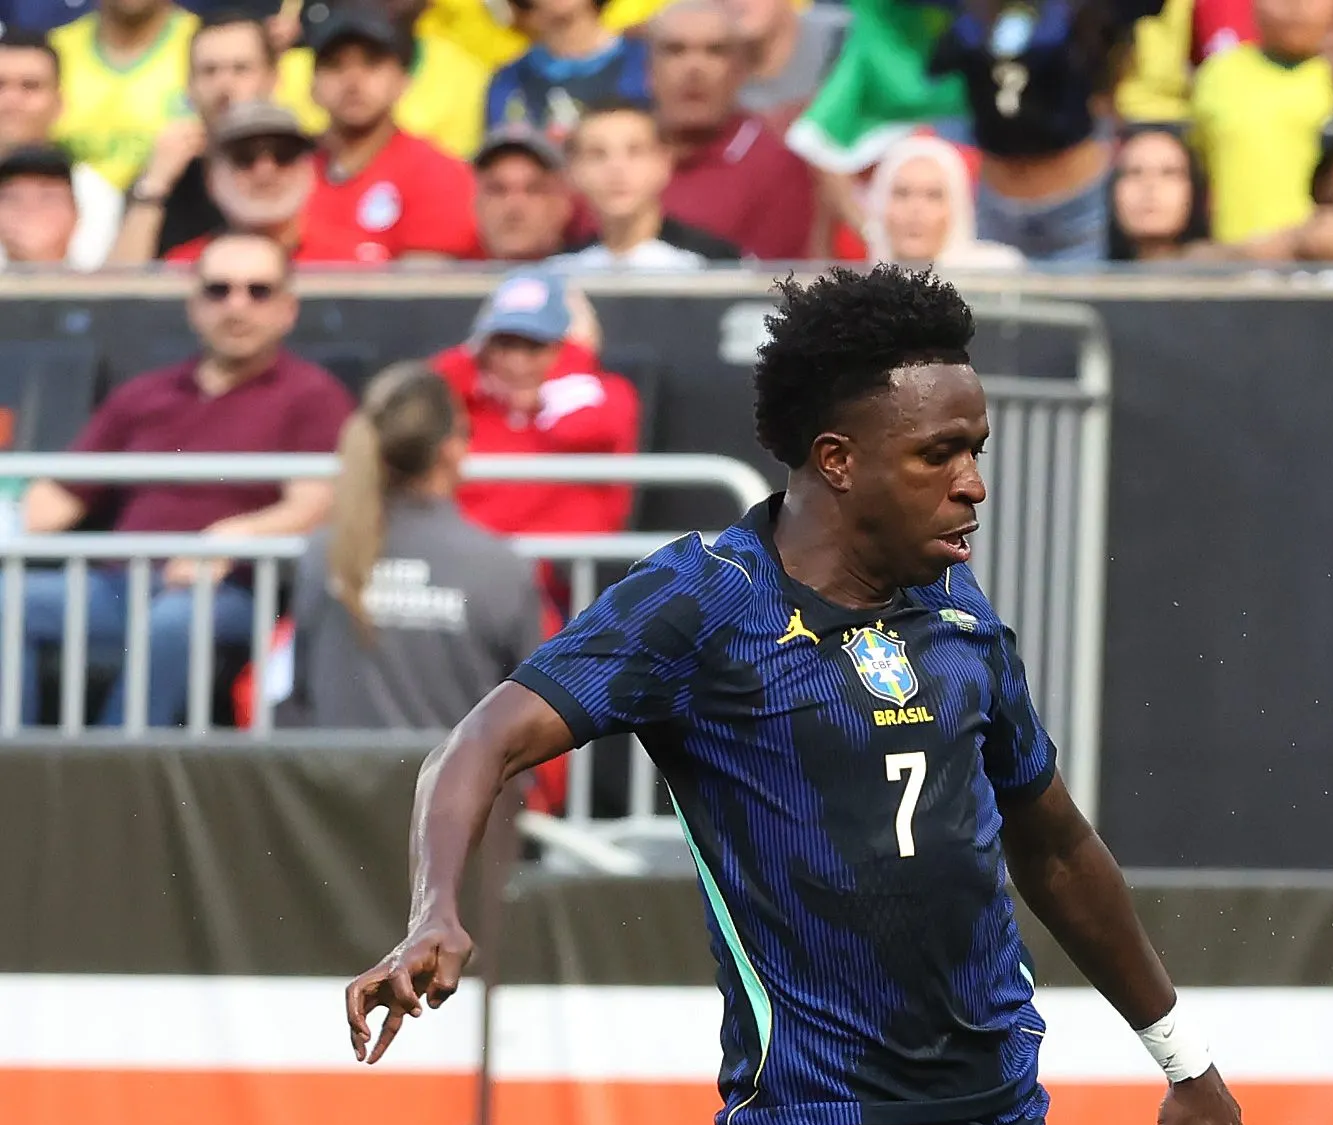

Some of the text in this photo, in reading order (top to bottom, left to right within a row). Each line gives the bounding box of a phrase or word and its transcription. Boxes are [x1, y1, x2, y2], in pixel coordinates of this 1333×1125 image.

[871, 660, 893, 670] CBF
[873, 706, 934, 726] BRASIL
[885, 751, 927, 858] 7
